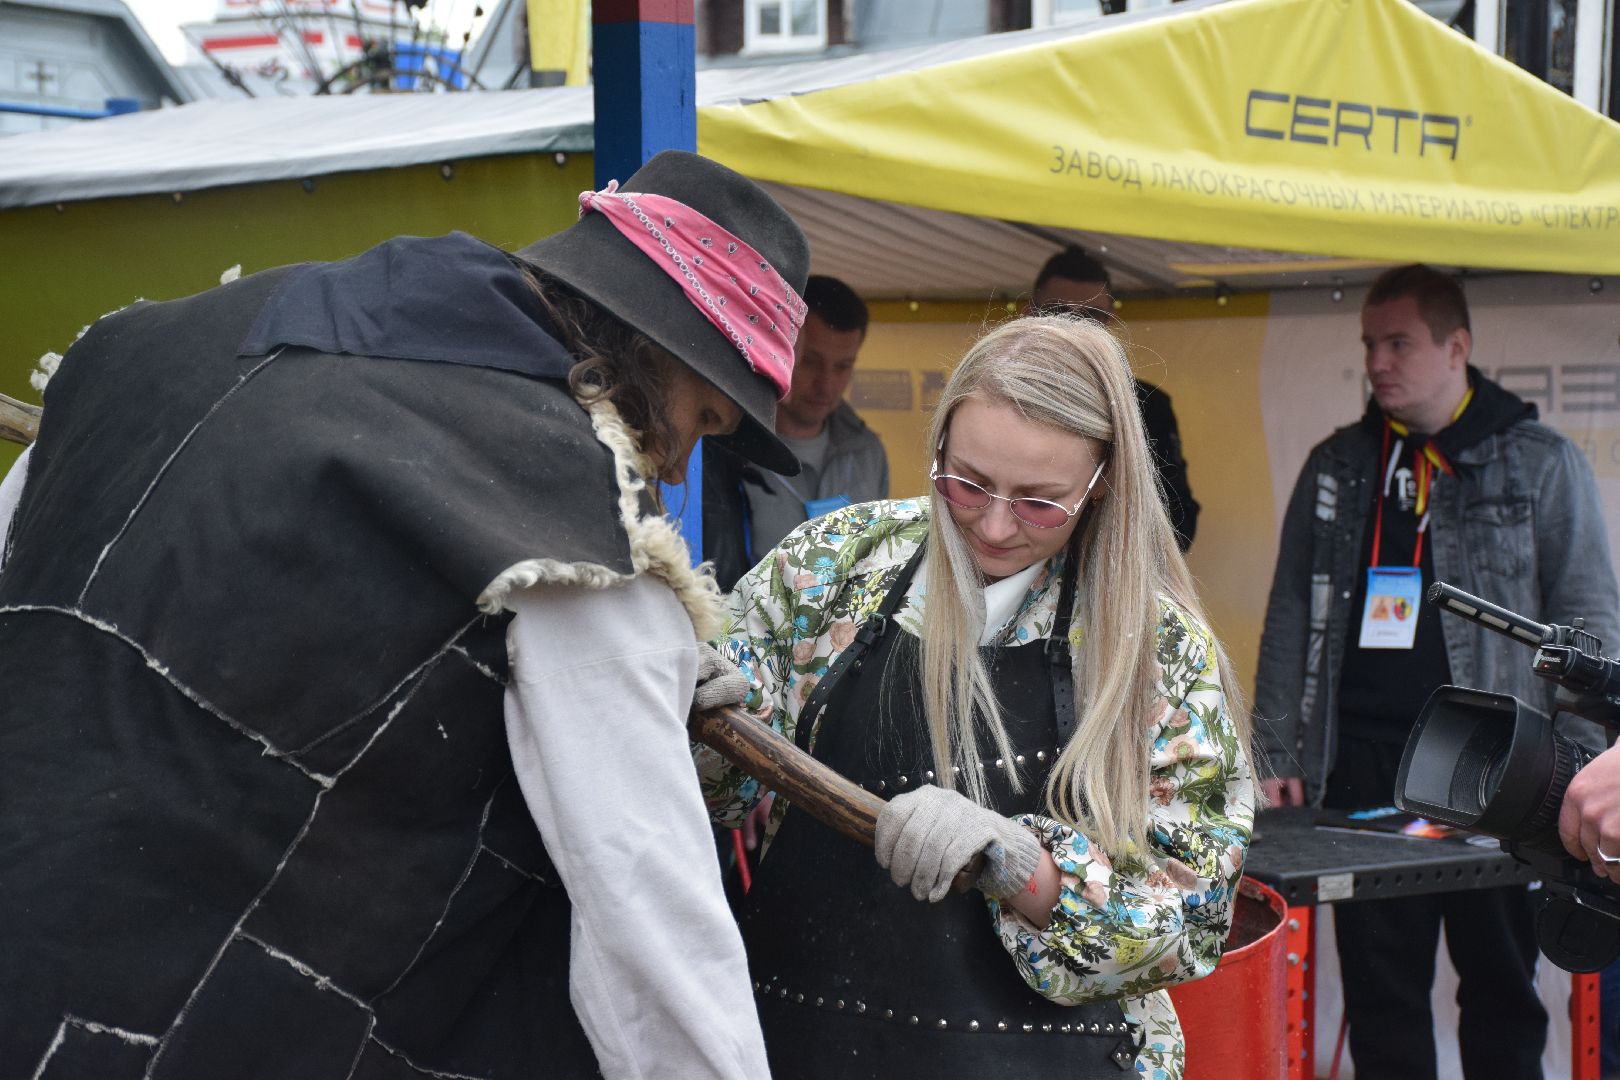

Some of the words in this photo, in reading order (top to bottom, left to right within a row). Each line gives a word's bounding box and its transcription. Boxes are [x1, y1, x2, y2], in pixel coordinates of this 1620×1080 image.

[1049, 145, 1143, 192] ЗАВОД
[1152, 162, 1366, 212] ЛАКОКРАСОЧНЫХ
[1370, 189, 1524, 226] МАТЕРИАЛОВ
